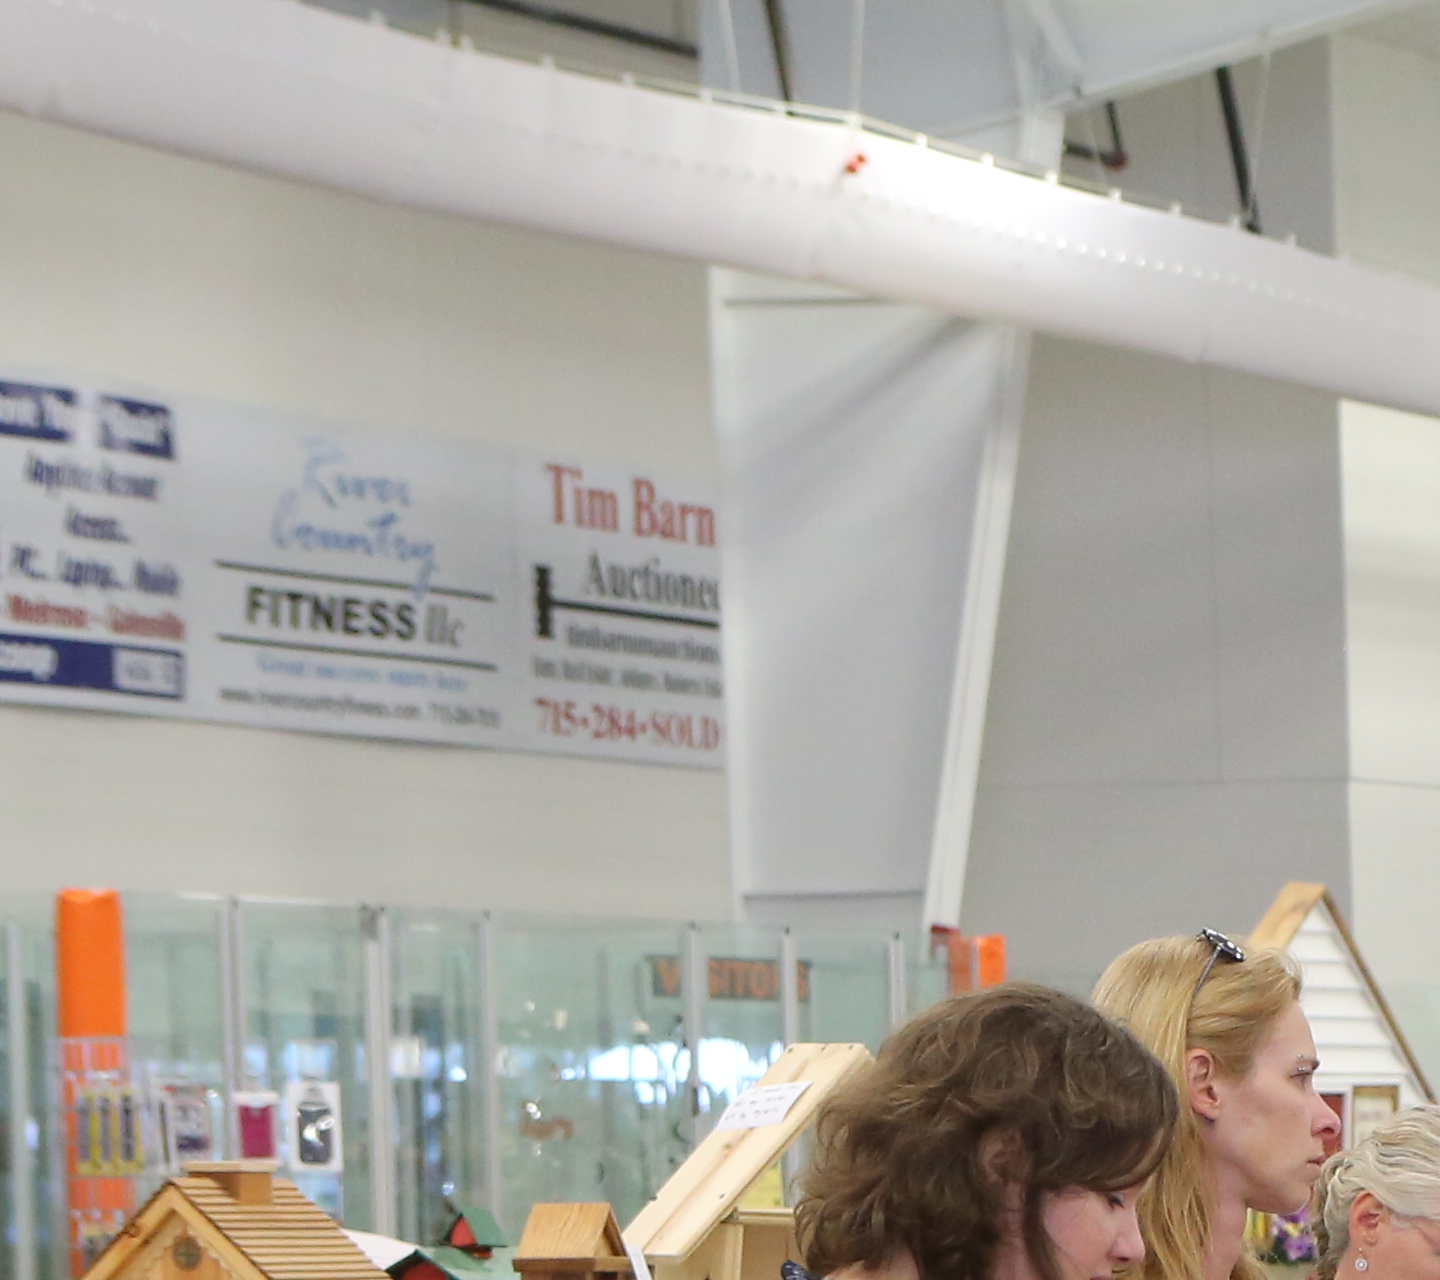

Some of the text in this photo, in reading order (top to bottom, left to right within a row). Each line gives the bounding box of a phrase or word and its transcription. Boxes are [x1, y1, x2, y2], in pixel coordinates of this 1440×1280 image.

[547, 463, 717, 548] Tim Barn
[246, 584, 417, 641] FITNESS
